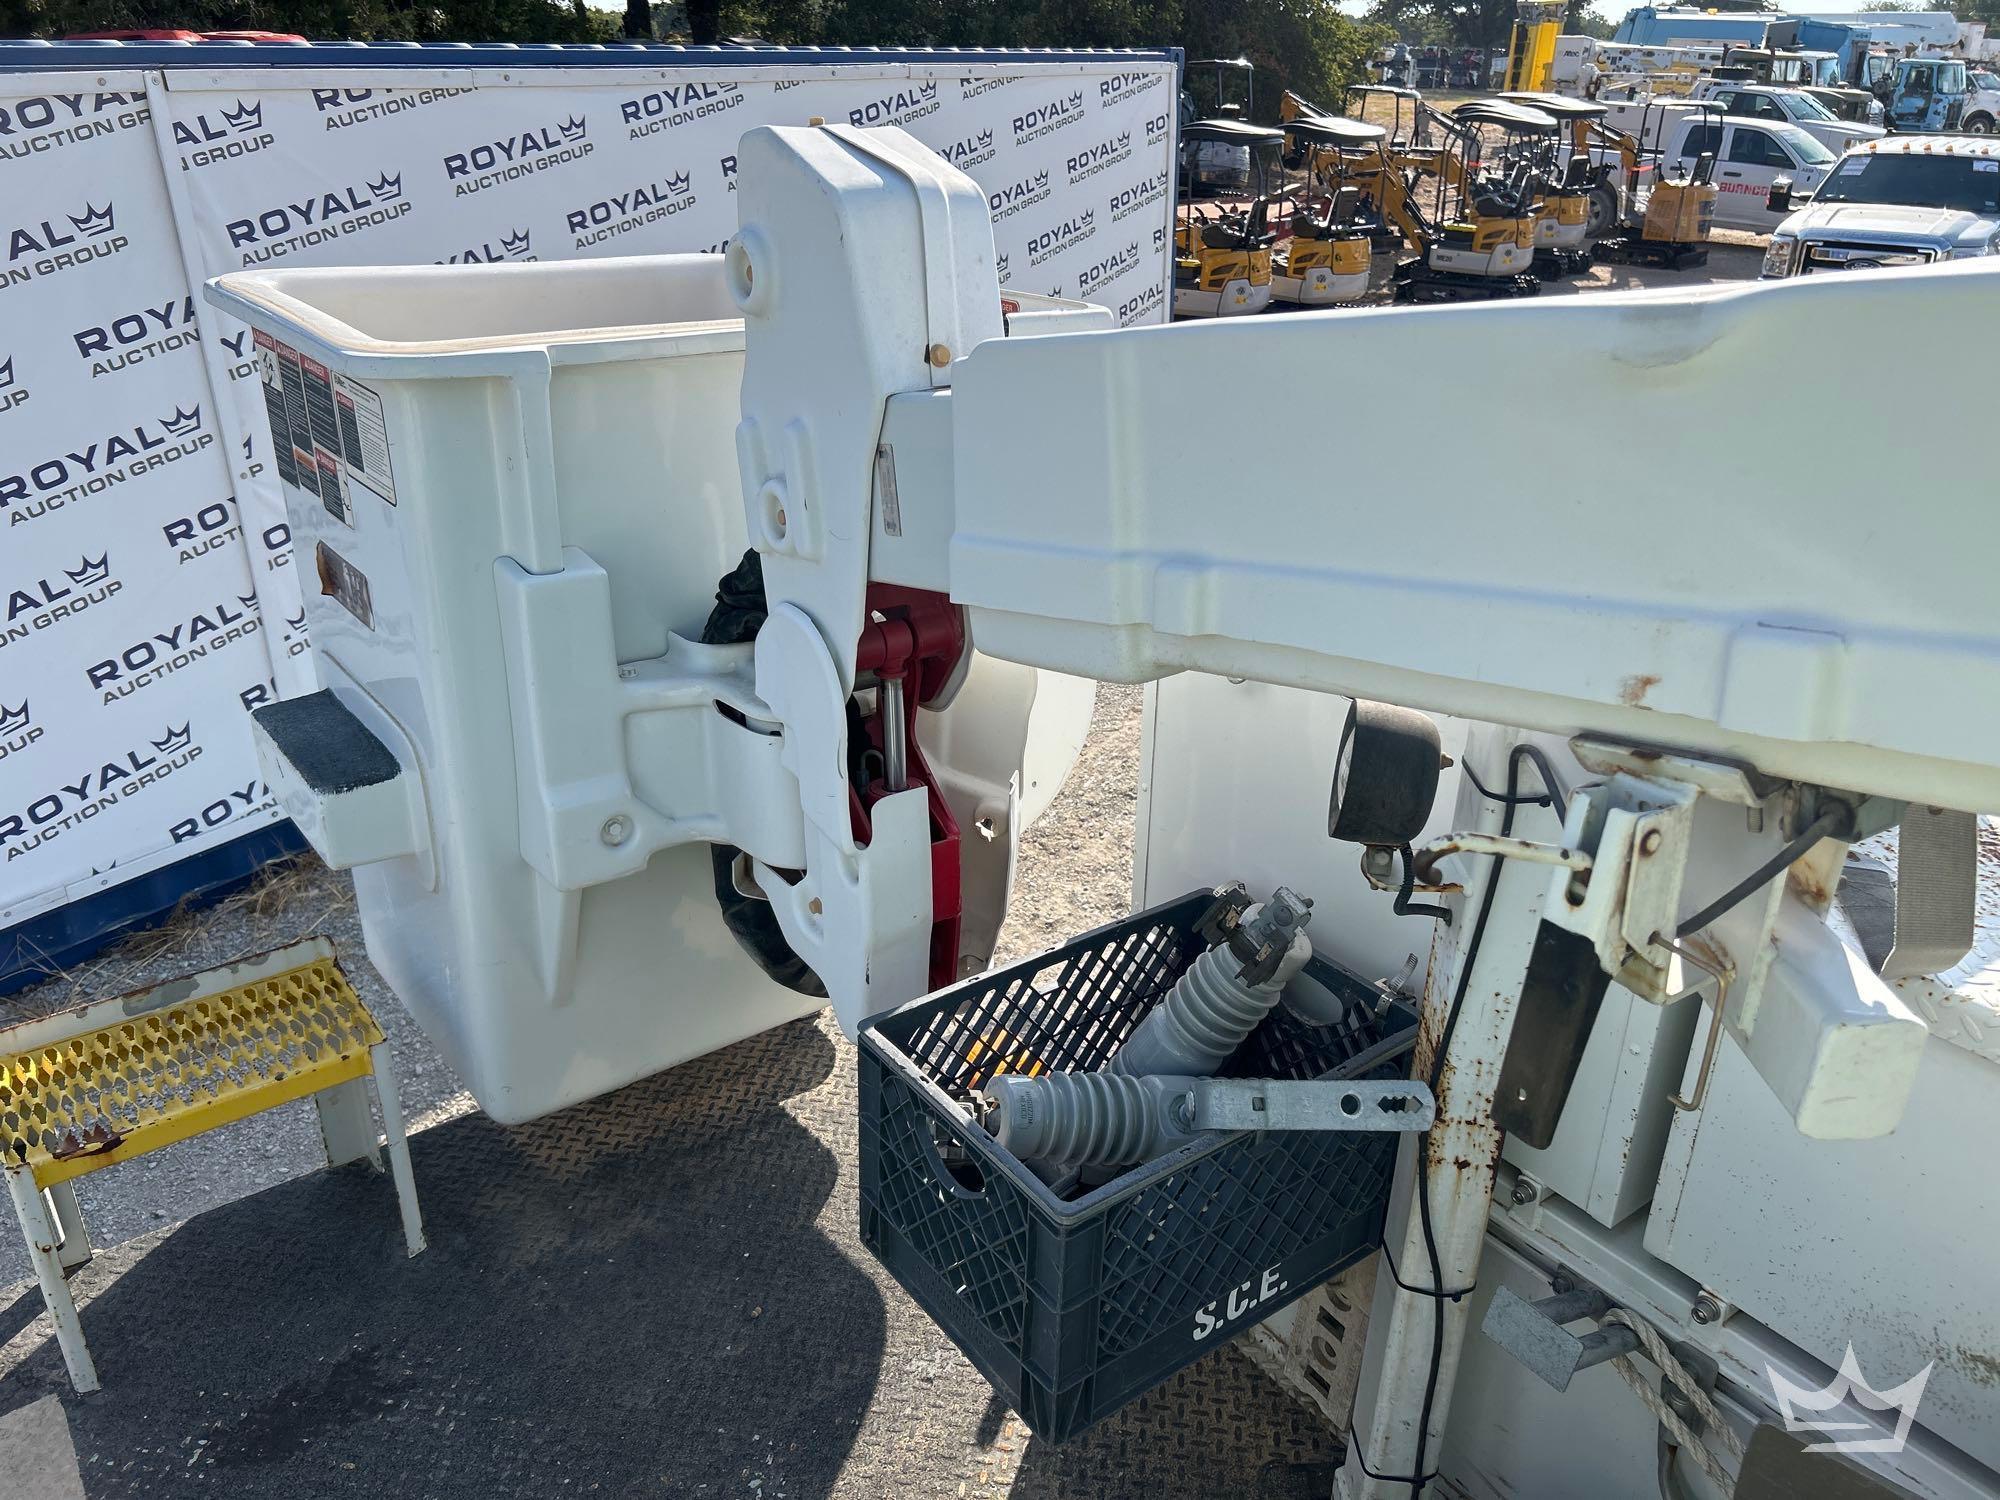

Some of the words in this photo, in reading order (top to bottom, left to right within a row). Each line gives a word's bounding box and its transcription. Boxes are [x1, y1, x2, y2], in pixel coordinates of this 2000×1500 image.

[326, 95, 417, 132] AUCTION
[620, 82, 718, 125] ROYAL
[849, 88, 921, 127] ROYAL
[904, 101, 940, 124] GROUP
[1102, 88, 1136, 109] AUCTION
[1136, 76, 1162, 93] GROUP
[629, 110, 694, 141] AUCTION
[696, 93, 744, 119] GROUP
[1013, 99, 1070, 135] ROYAL
[1016, 123, 1055, 147] AUCTION
[1055, 110, 1085, 130] GROUP
[1145, 113, 1169, 136] RO
[192, 133, 275, 170] GROUP
[444, 127, 562, 180] ROYAL
[455, 162, 534, 198] AUCTION
[536, 142, 594, 172] GROUP
[963, 149, 996, 171] GROUP
[1067, 139, 1118, 174] ROYAL
[1069, 163, 1105, 187] AUCTION
[1105, 149, 1132, 168] GROUP
[566, 183, 669, 234] ROYAL
[1020, 188, 1051, 209] GROUP
[1110, 178, 1157, 212] ROYAL
[1112, 200, 1144, 223] AUCTION
[225, 186, 372, 249] ROYAL
[242, 225, 339, 268] AUCTION
[340, 201, 412, 235] GROUP
[575, 215, 643, 251] AUCTION
[645, 195, 697, 224] GROUP
[1028, 218, 1082, 256] ROYAL
[35, 234, 129, 276] GROUP
[1030, 240, 1067, 268] AUCTION
[1067, 226, 1096, 247] GROUP
[1079, 251, 1127, 288] ROYAL
[1080, 274, 1114, 299] AUCTION
[1114, 258, 1140, 279] GROUP
[1119, 283, 1163, 320] ROYAL
[92, 328, 200, 379] AUCTION
[0, 426, 166, 507] ROYAL
[10, 469, 127, 527] AUCTION
[129, 433, 214, 477] GROUP
[32, 580, 123, 630] GROUP
[86, 603, 243, 691] ROYAL
[103, 644, 208, 707] AUCTION
[0, 750, 157, 843] ROYAL
[7, 791, 119, 862] AUCTION
[121, 745, 203, 798] GROUP
[1193, 1262, 1288, 1341] S.C.E.
